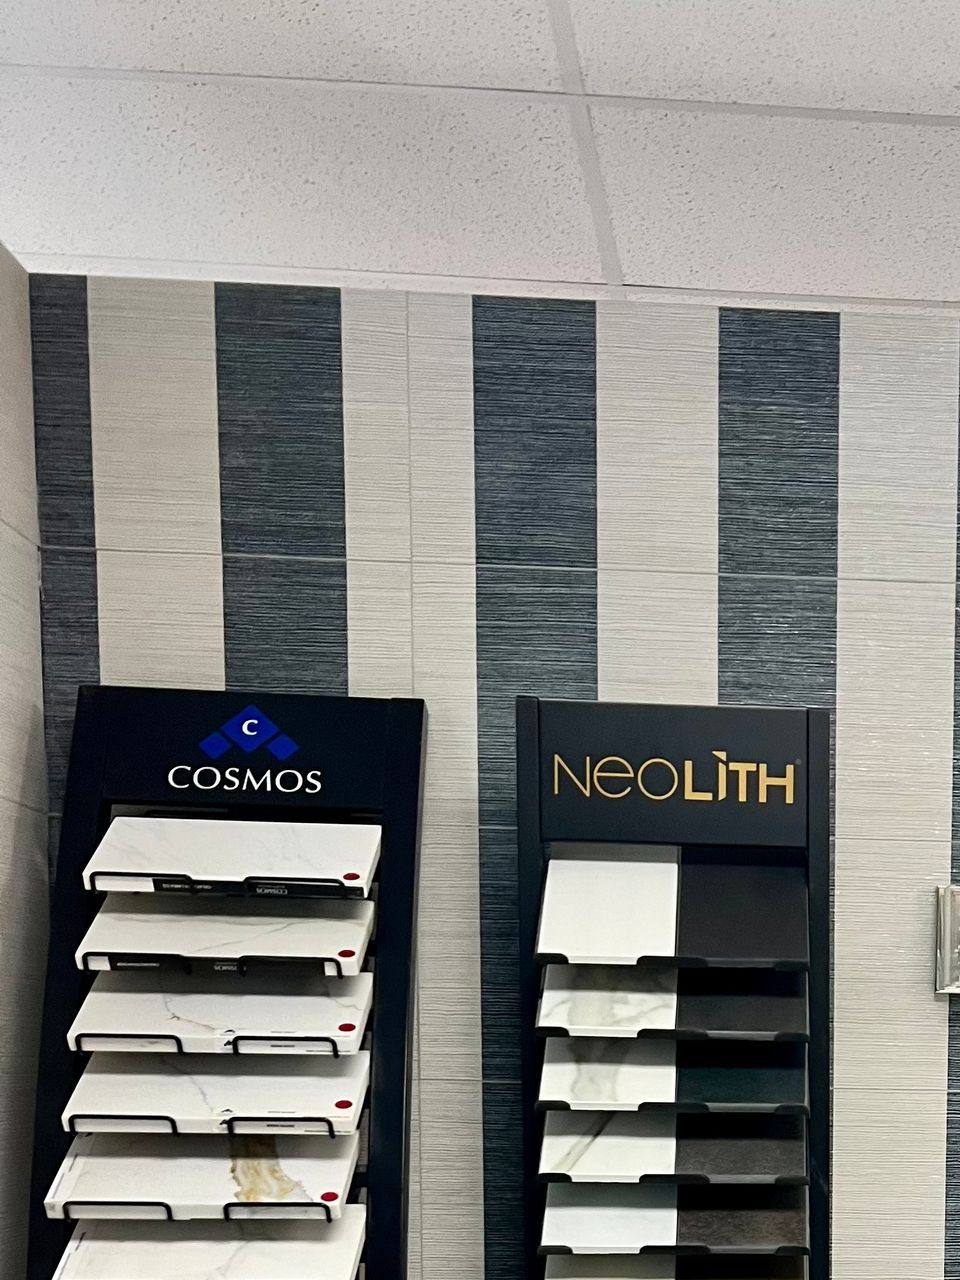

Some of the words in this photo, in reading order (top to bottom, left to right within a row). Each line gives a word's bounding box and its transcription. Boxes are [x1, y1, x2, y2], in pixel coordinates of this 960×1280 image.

[242, 718, 258, 736] C
[167, 765, 322, 794] COSMOS
[256, 887, 288, 895] COSMOS
